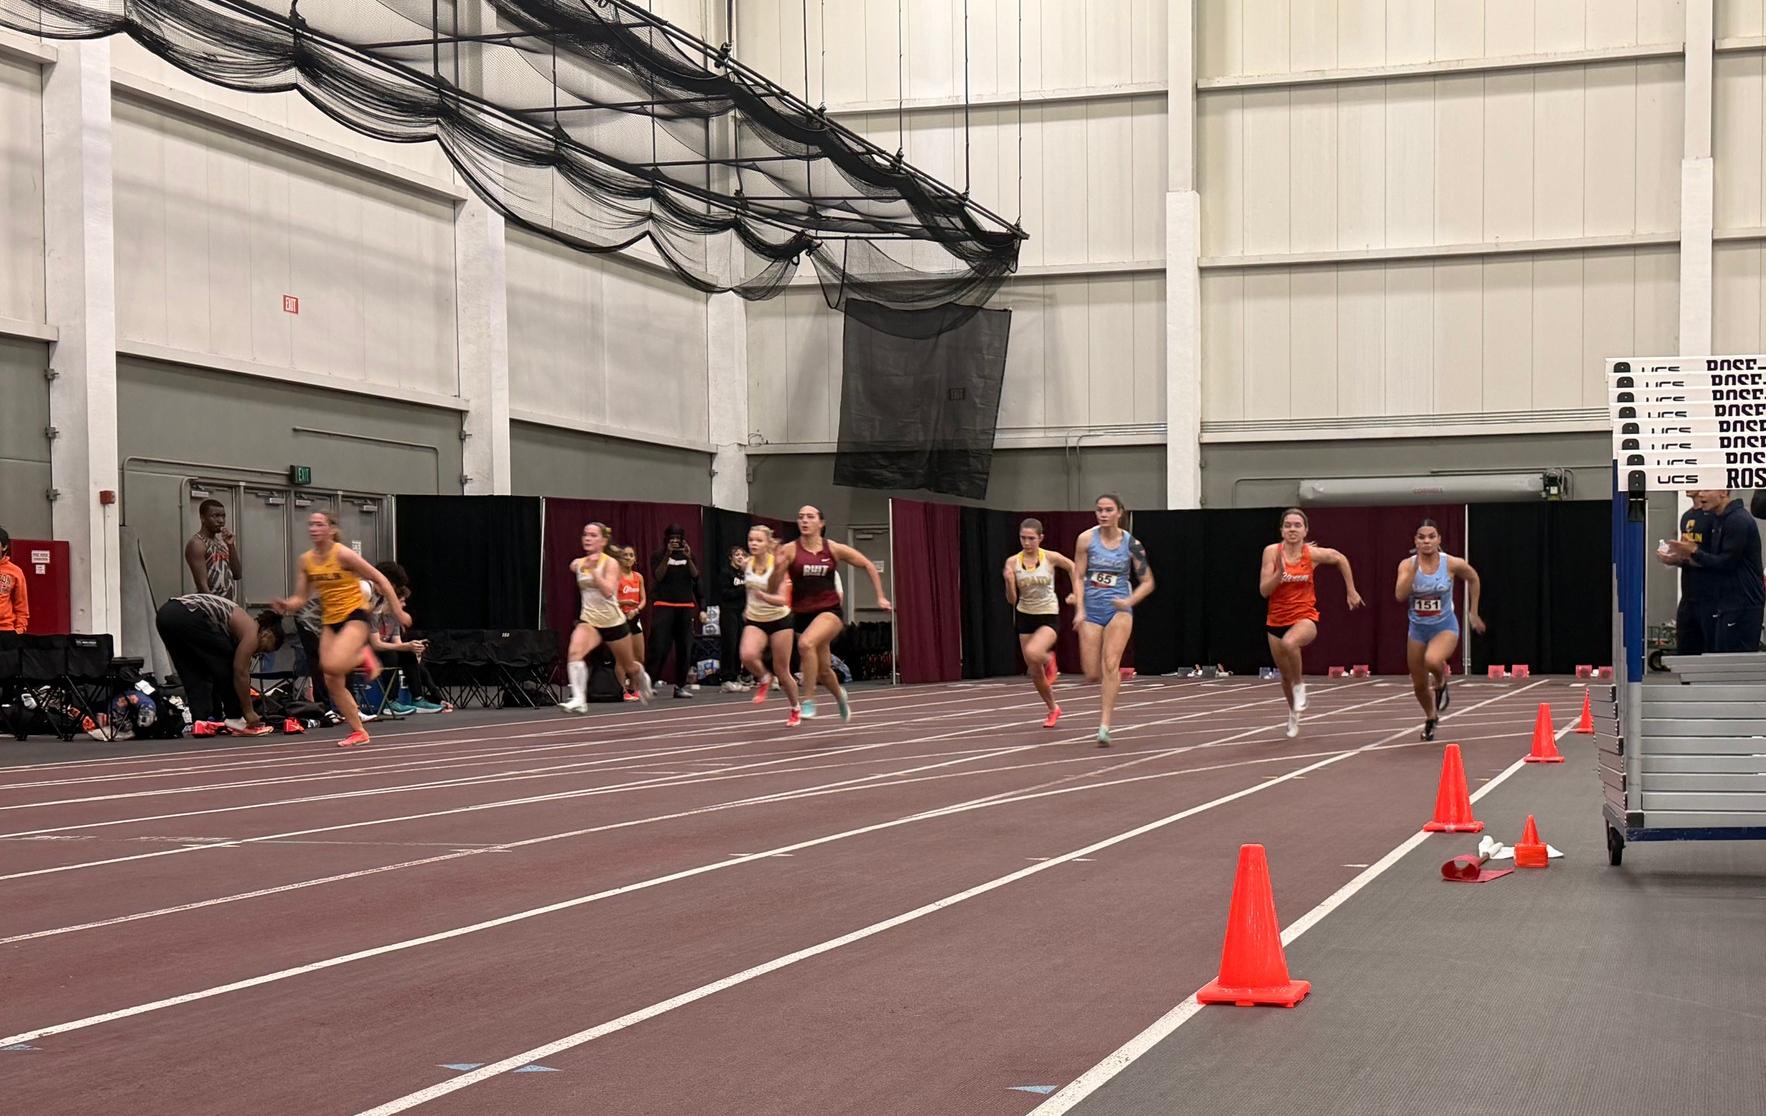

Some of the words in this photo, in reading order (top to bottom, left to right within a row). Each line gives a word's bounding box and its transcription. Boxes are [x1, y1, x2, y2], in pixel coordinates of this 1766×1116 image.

[285, 296, 297, 313] EXIT
[1658, 475, 1698, 484] UCS
[1726, 468, 1766, 488] ROS
[1097, 573, 1112, 584] 65
[1416, 600, 1439, 610] 151
